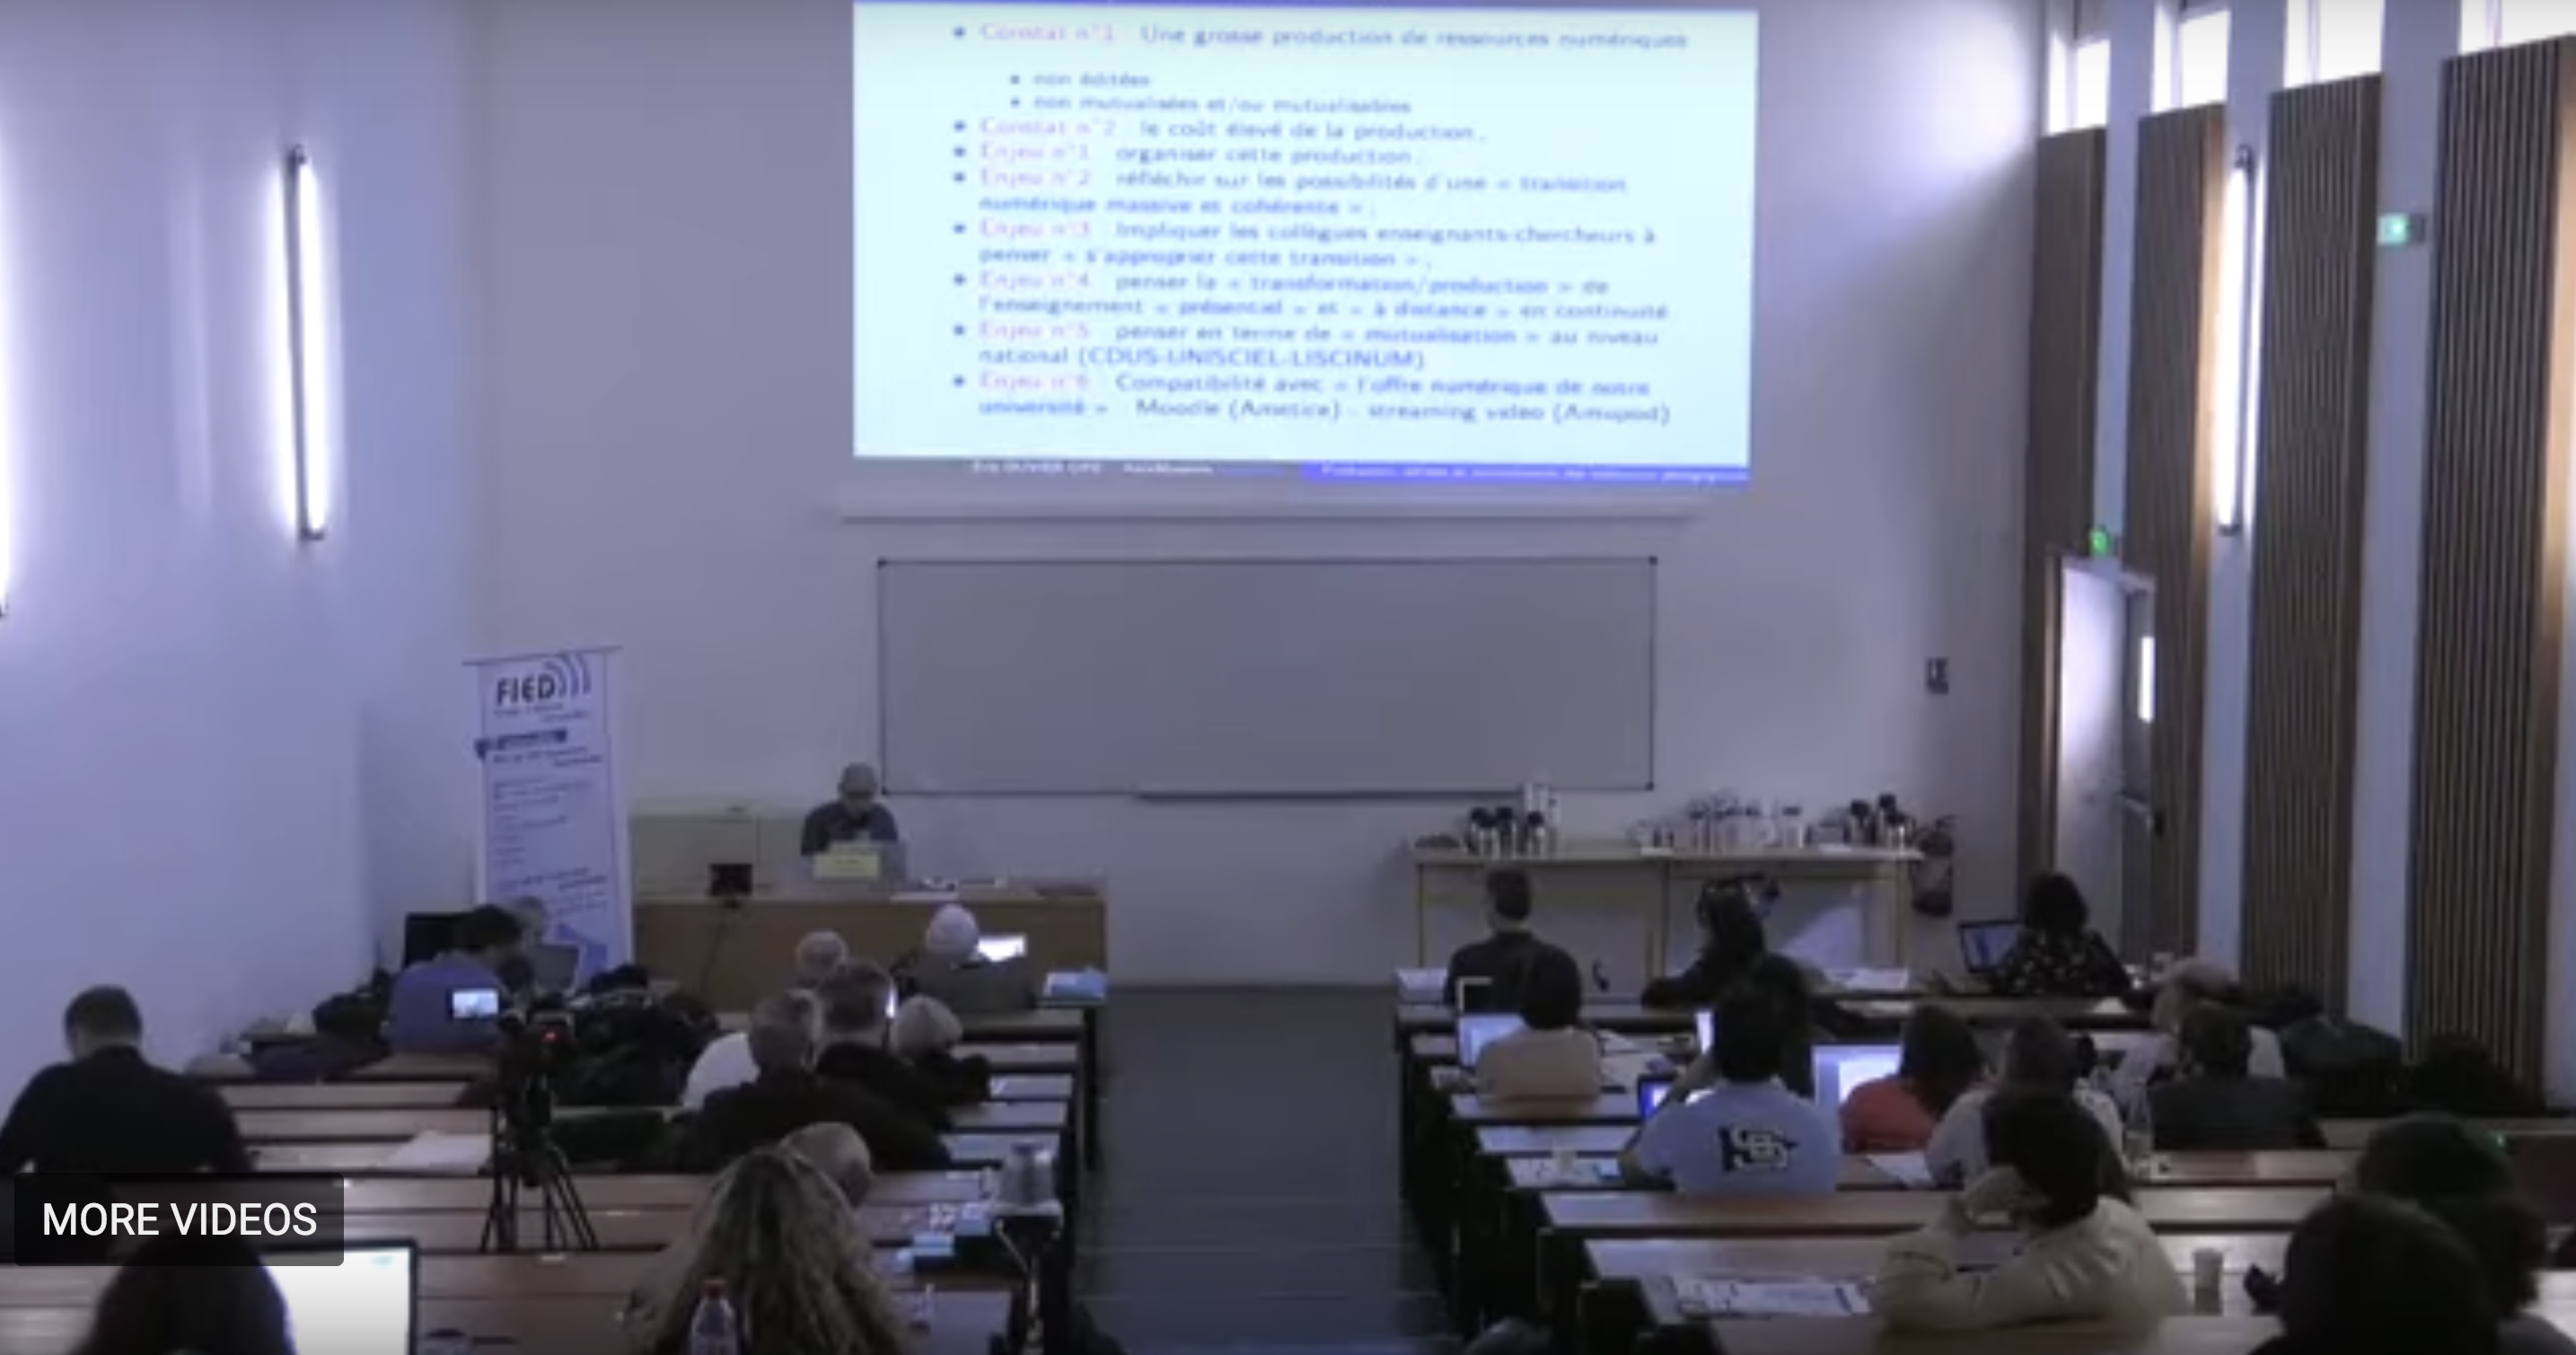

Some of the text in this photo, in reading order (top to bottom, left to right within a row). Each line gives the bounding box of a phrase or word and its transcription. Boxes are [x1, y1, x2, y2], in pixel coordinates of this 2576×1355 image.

[1140, 24, 1185, 44] Une
[1192, 31, 1263, 48] grosse
[1272, 29, 1394, 48] production
[1400, 29, 1428, 45] de
[1436, 32, 1550, 48] ressources
[1559, 31, 1687, 50] numériques
[1033, 75, 1072, 86] non
[1033, 96, 1072, 110] non
[1139, 121, 1161, 137] le
[1167, 119, 1218, 137] coût
[1225, 121, 1284, 138] élevé
[1290, 123, 1319, 138] de
[1325, 122, 1347, 138] la
[1115, 148, 1217, 166] organiser
[1225, 147, 1283, 163] cette
[1214, 175, 1249, 189] sur
[1257, 172, 1287, 189] les
[1519, 176, 1626, 193] transition
[978, 196, 1097, 215] numérique
[1104, 199, 1193, 215] massive
[1200, 200, 1222, 214] et
[1229, 224, 1260, 240] les
[1643, 229, 1656, 244] à
[977, 248, 1051, 264] penser
[1224, 251, 1282, 266] cette
[1288, 251, 1396, 268] transition
[1115, 277, 1189, 294] penser
[1196, 274, 1218, 291] la
[1581, 280, 1610, 295] de
[1317, 302, 1339, 315] et
[1374, 303, 1387, 317] à
[1394, 301, 1488, 319] distance
[1519, 304, 1546, 320] en
[1115, 326, 1188, 343] penser
[1196, 327, 1223, 339] en
[1232, 326, 1297, 341] terme
[1304, 326, 1332, 341] de
[1364, 327, 1517, 344] mutualisation
[1551, 331, 1578, 345] au
[1587, 330, 1658, 346] niveau
[977, 346, 1071, 365] national
[1115, 372, 1267, 394] Compatibilité
[1273, 379, 1323, 392] avec
[1430, 378, 1548, 397] numérique
[1556, 379, 1584, 396] de
[1136, 398, 1220, 417] Moodle
[1367, 405, 1477, 424] streaming
[496, 673, 556, 706] FIED
